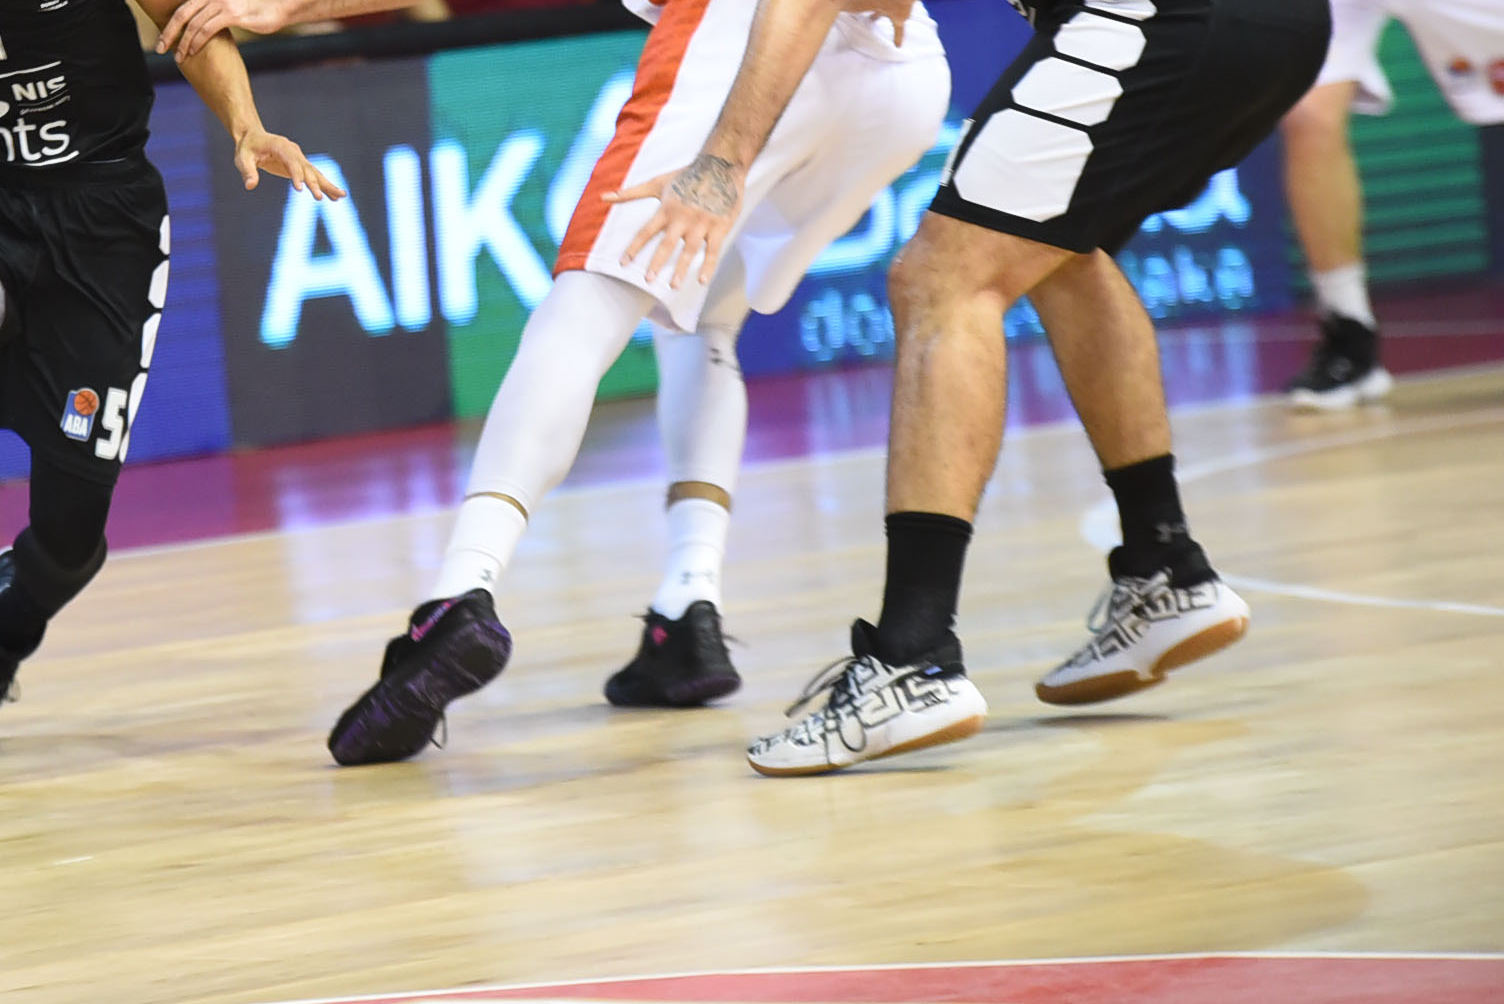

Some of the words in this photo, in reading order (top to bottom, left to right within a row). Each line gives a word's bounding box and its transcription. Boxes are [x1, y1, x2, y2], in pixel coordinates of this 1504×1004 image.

[11, 75, 68, 102] NIS
[63, 413, 89, 438] ABA
[94, 386, 128, 461] 5
